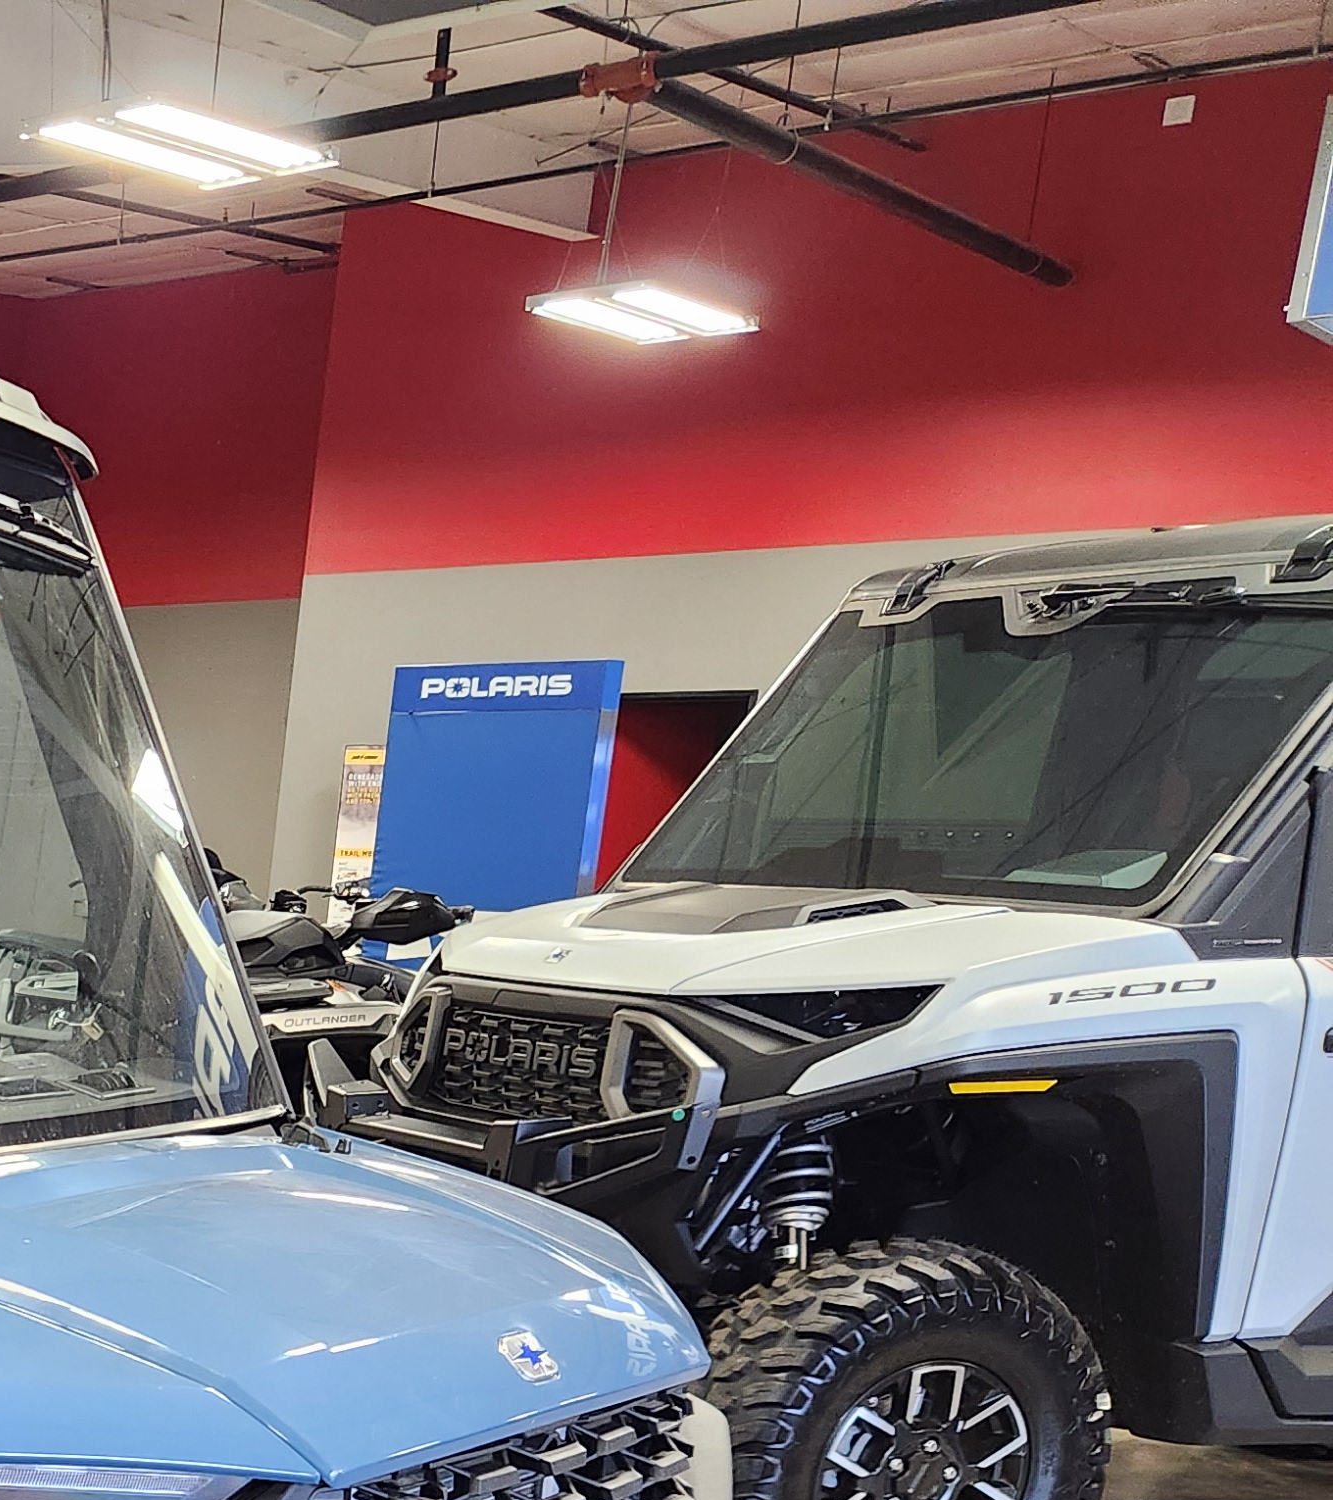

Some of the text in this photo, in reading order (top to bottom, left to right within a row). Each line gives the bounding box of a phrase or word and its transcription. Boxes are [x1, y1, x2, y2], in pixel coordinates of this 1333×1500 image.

[420, 674, 572, 699] POLARIS
[1048, 978, 1216, 1006] 1500
[284, 1014, 366, 1028] OUTLANDER
[443, 1027, 598, 1079] POLARIS
